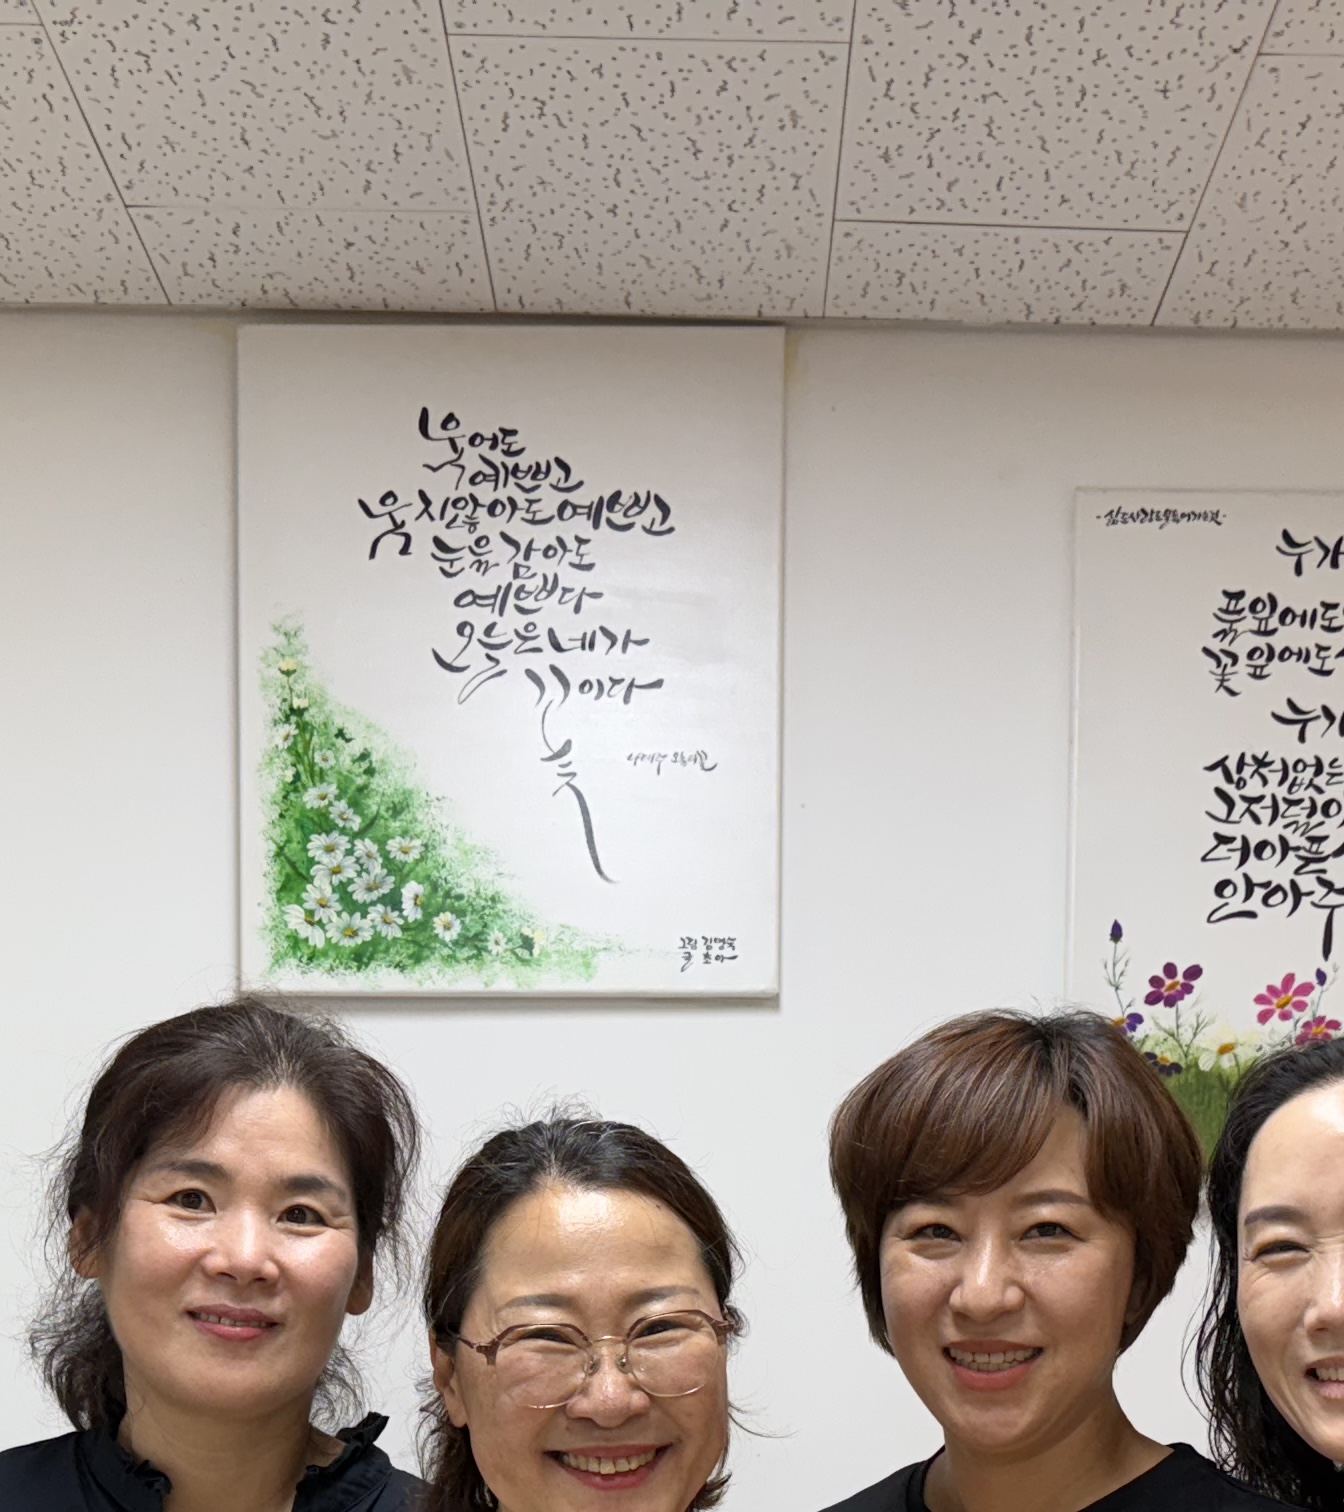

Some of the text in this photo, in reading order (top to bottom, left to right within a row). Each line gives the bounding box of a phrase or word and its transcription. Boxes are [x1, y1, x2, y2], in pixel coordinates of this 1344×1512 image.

[453, 573, 604, 617] 예쁘다
[524, 663, 665, 884] 꽃이다
[678, 936, 698, 951] 그림
